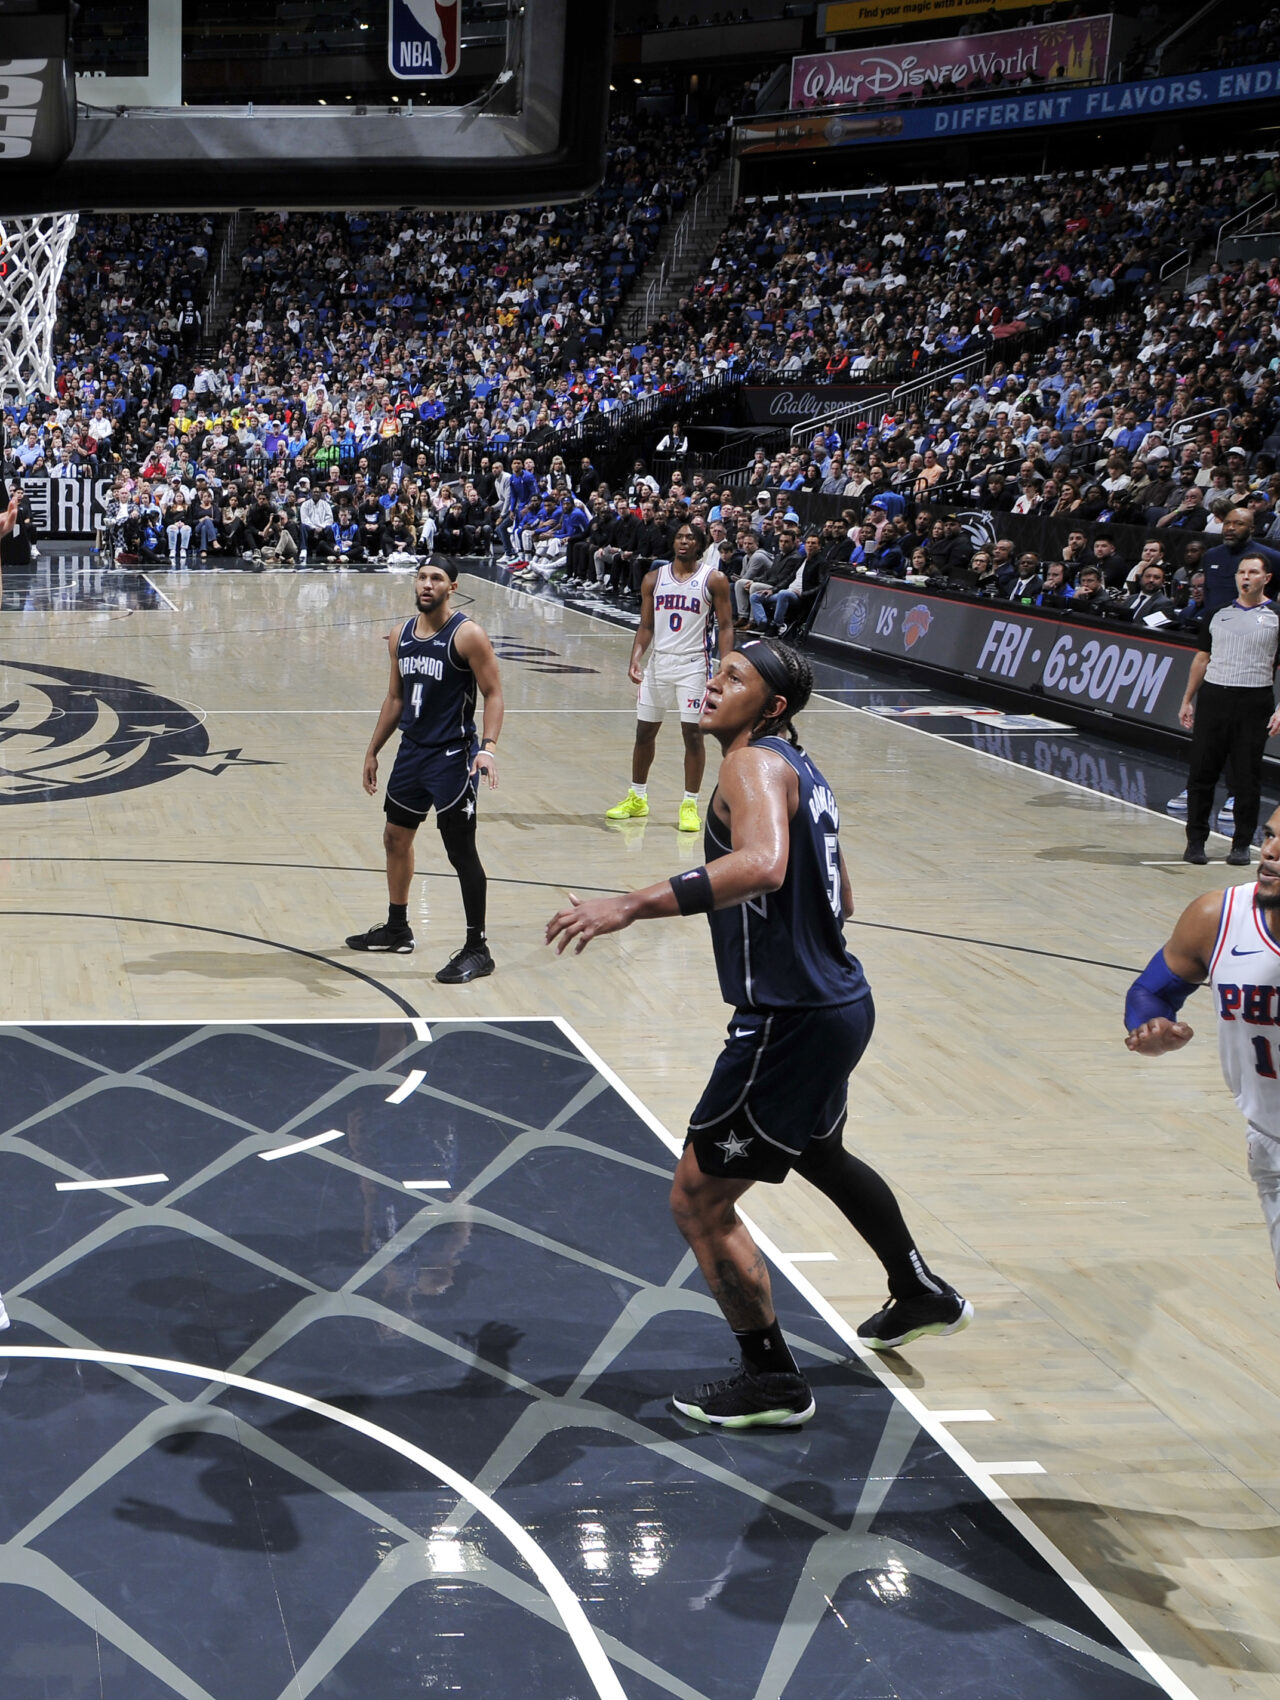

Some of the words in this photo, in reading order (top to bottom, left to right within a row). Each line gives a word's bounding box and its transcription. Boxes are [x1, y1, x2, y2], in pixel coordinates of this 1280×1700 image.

[903, 1, 932, 15] magic
[400, 41, 433, 67] NBA
[968, 45, 1039, 77] World
[934, 96, 1072, 132] DIFFERENT
[1085, 80, 1209, 115] FLAVORS.
[769, 391, 823, 419] Bally
[655, 594, 701, 615] PHILA
[669, 612, 683, 632] 0
[875, 605, 898, 636] VS
[976, 620, 1033, 678] FRI
[1042, 634, 1174, 714] 6:30PM
[410, 683, 424, 718] 4
[687, 698, 701, 709] 76
